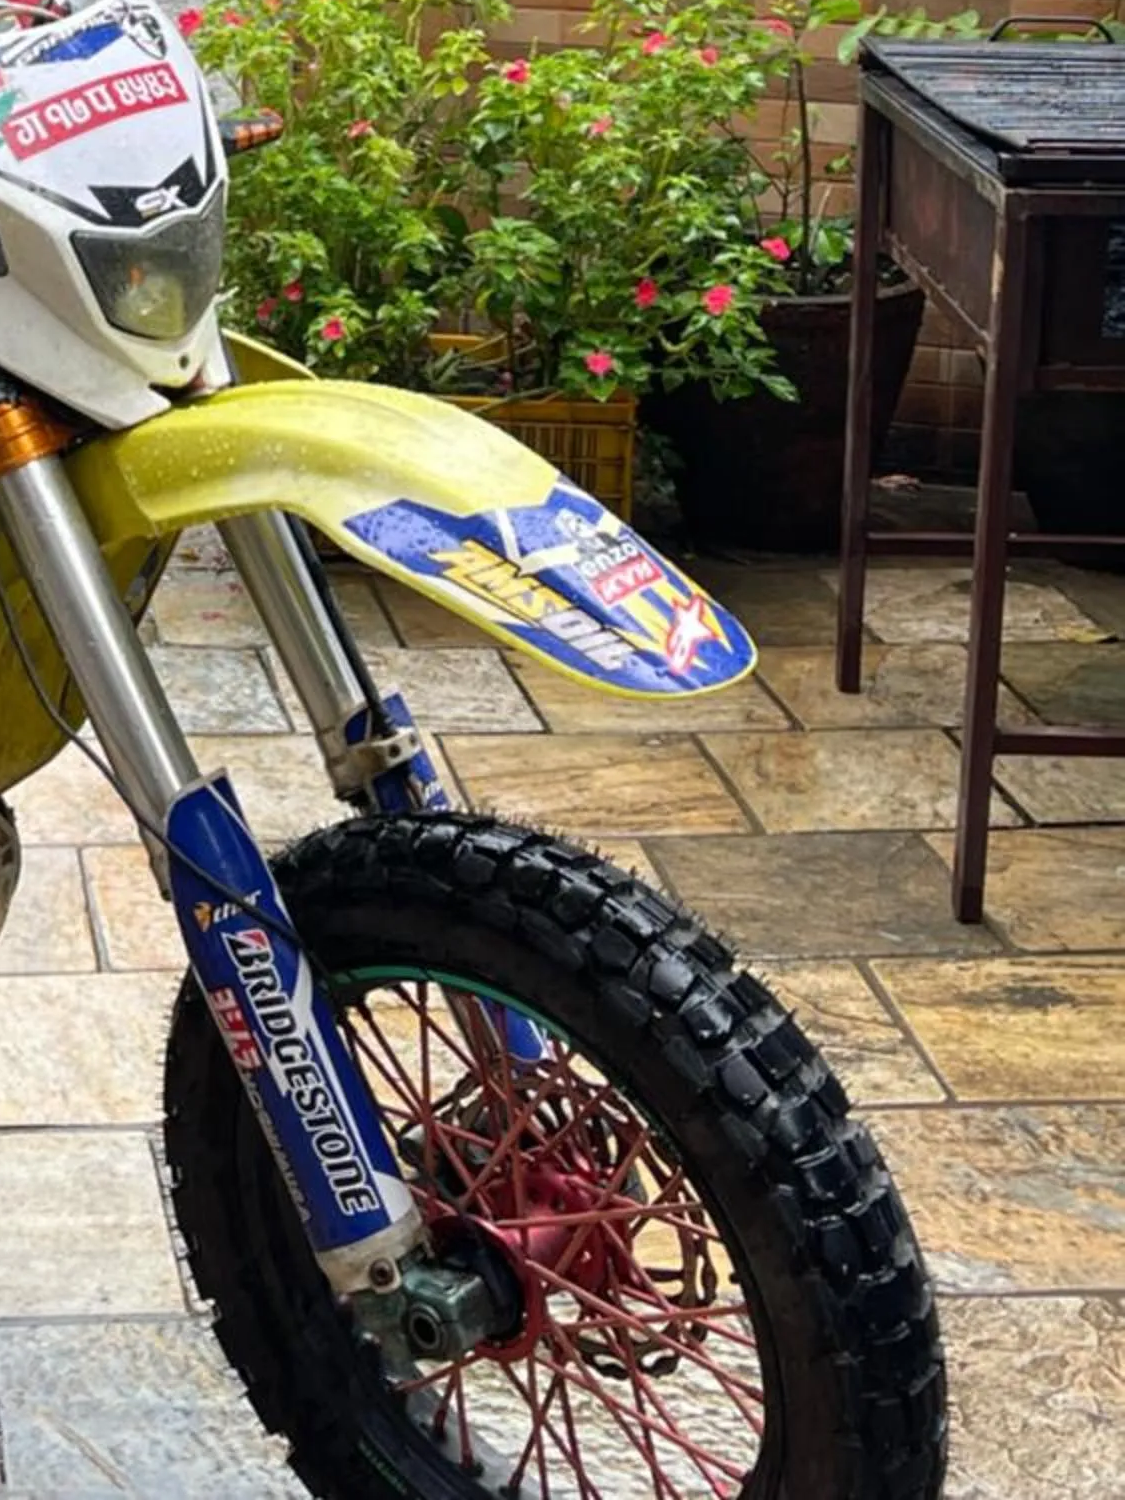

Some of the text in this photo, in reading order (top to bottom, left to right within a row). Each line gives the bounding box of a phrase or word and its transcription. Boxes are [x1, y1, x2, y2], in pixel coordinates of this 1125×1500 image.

[428, 538, 637, 671] AMSOIL
[213, 889, 262, 924] thr
[221, 928, 379, 1217] BRIDGESTONE
